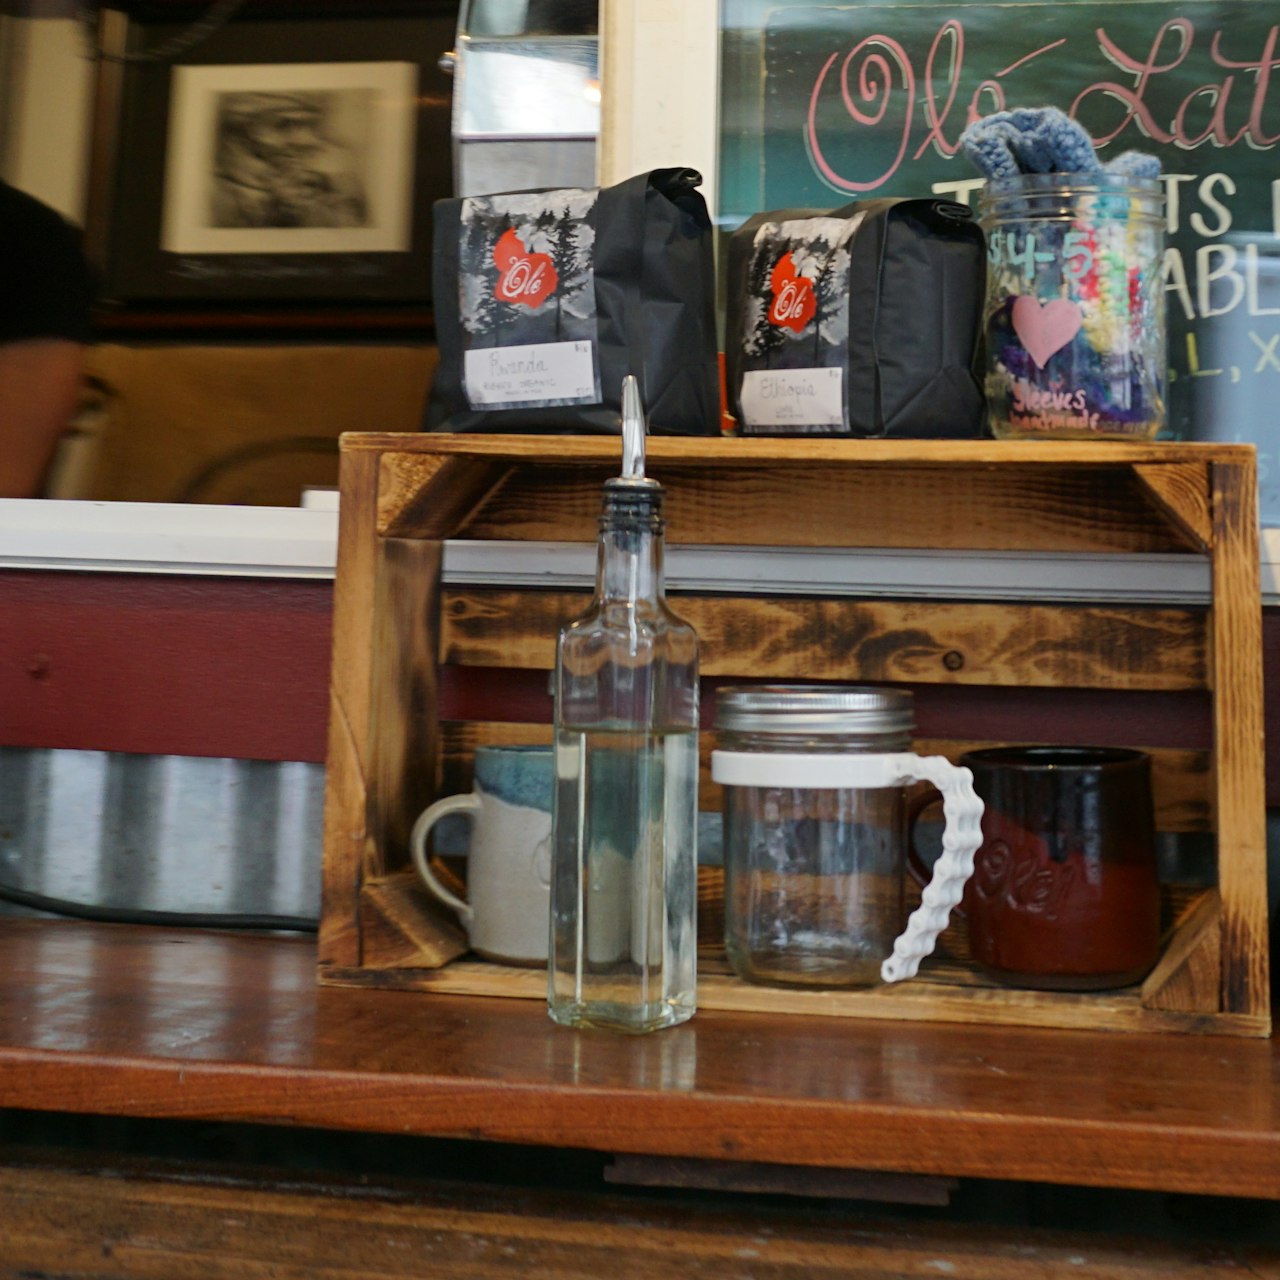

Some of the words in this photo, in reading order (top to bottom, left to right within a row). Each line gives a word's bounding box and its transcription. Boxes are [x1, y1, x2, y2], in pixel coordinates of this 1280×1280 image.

[501, 257, 544, 299] Olé
[773, 273, 808, 322] Olé
[760, 377, 816, 403] Ethiopia
